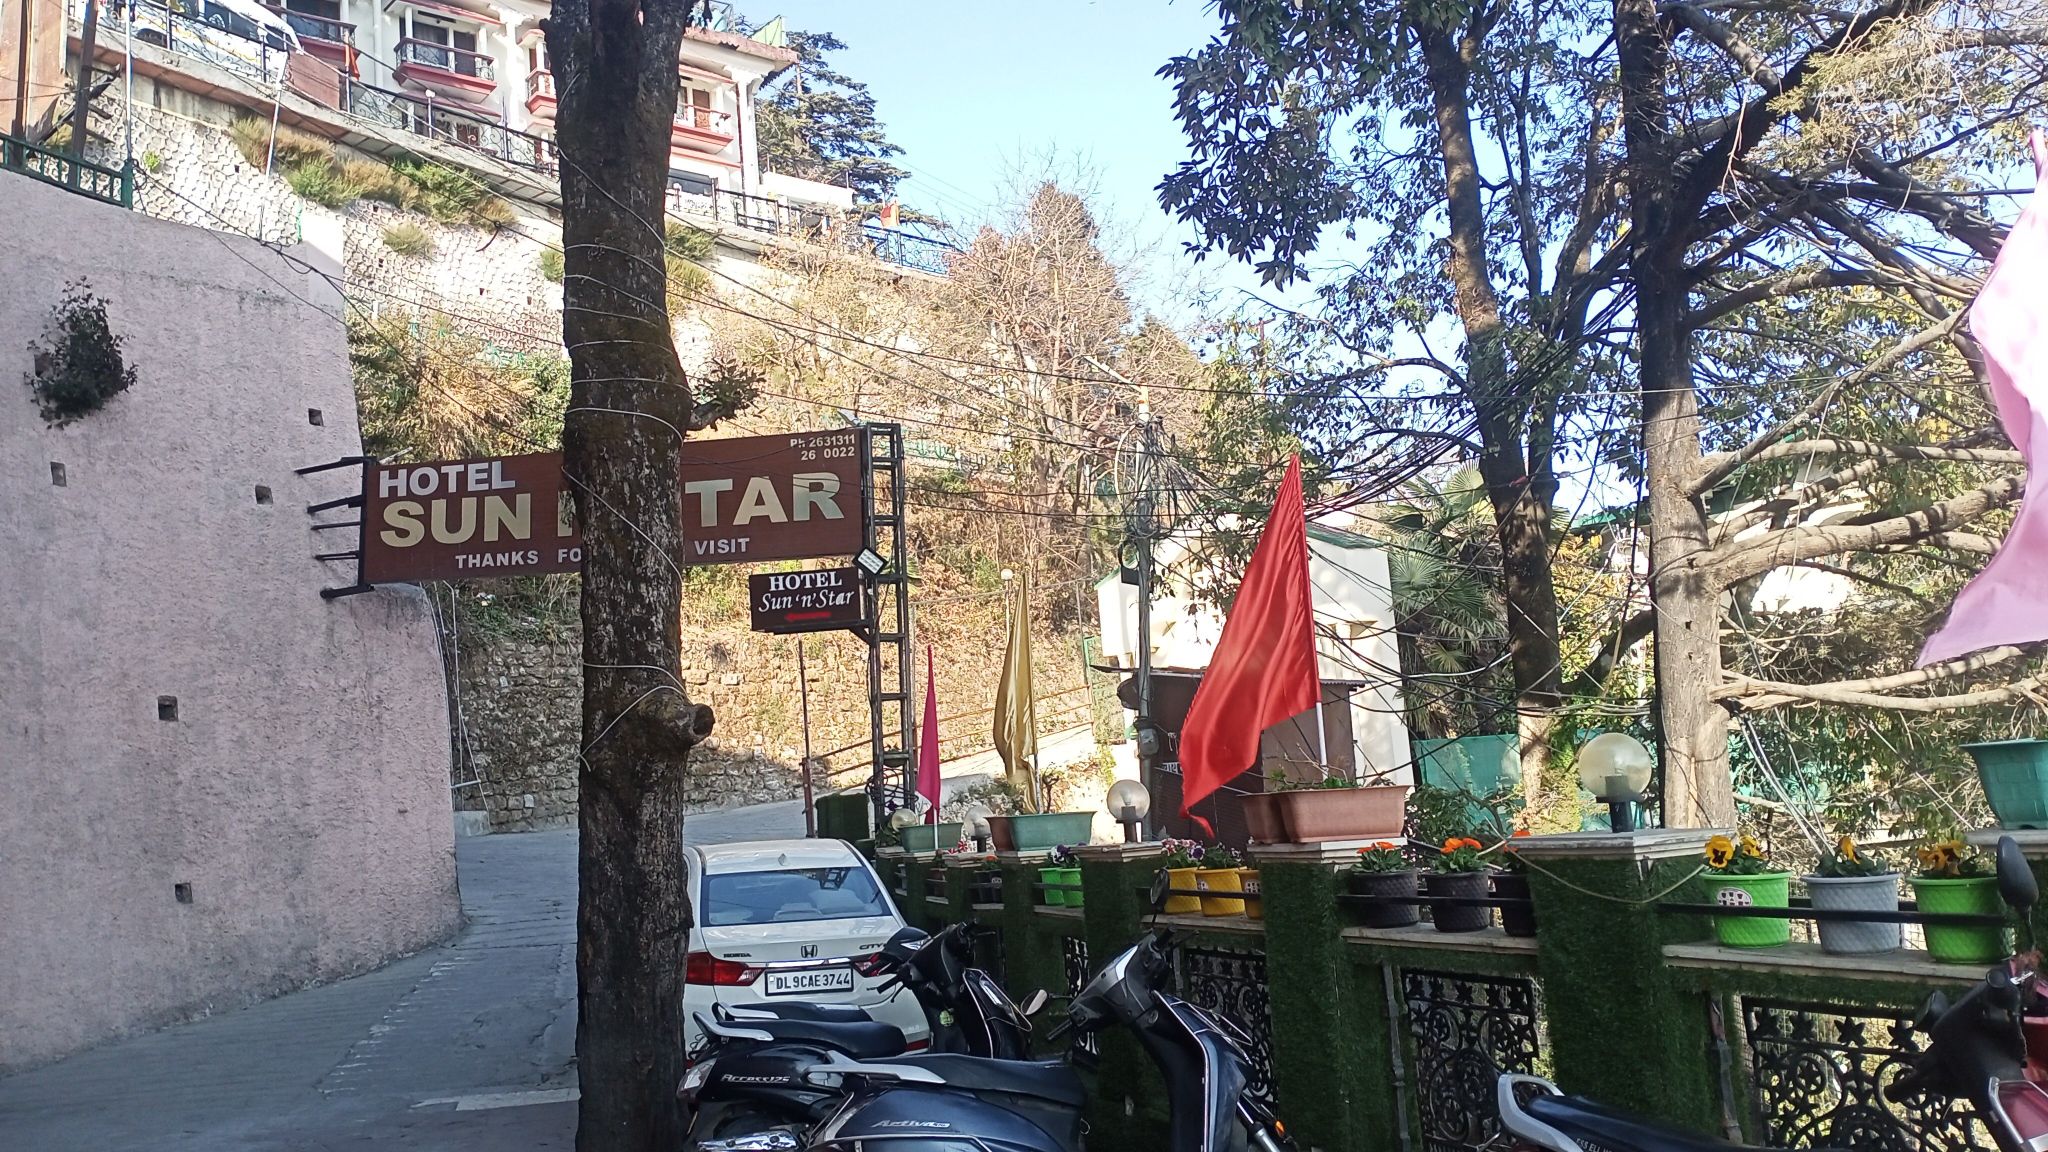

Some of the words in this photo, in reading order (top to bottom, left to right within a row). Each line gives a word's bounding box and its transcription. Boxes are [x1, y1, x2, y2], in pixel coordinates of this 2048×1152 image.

[801, 450, 816, 460] 26
[823, 446, 855, 458] 0022
[808, 434, 856, 448] 2631311
[379, 460, 516, 498] HOTEL
[380, 493, 531, 548] SUN
[684, 472, 845, 528] TAR
[455, 550, 539, 569] THANKS
[558, 547, 582, 563] FO
[694, 537, 750, 555] VISIT
[769, 571, 843, 591] HOTEL
